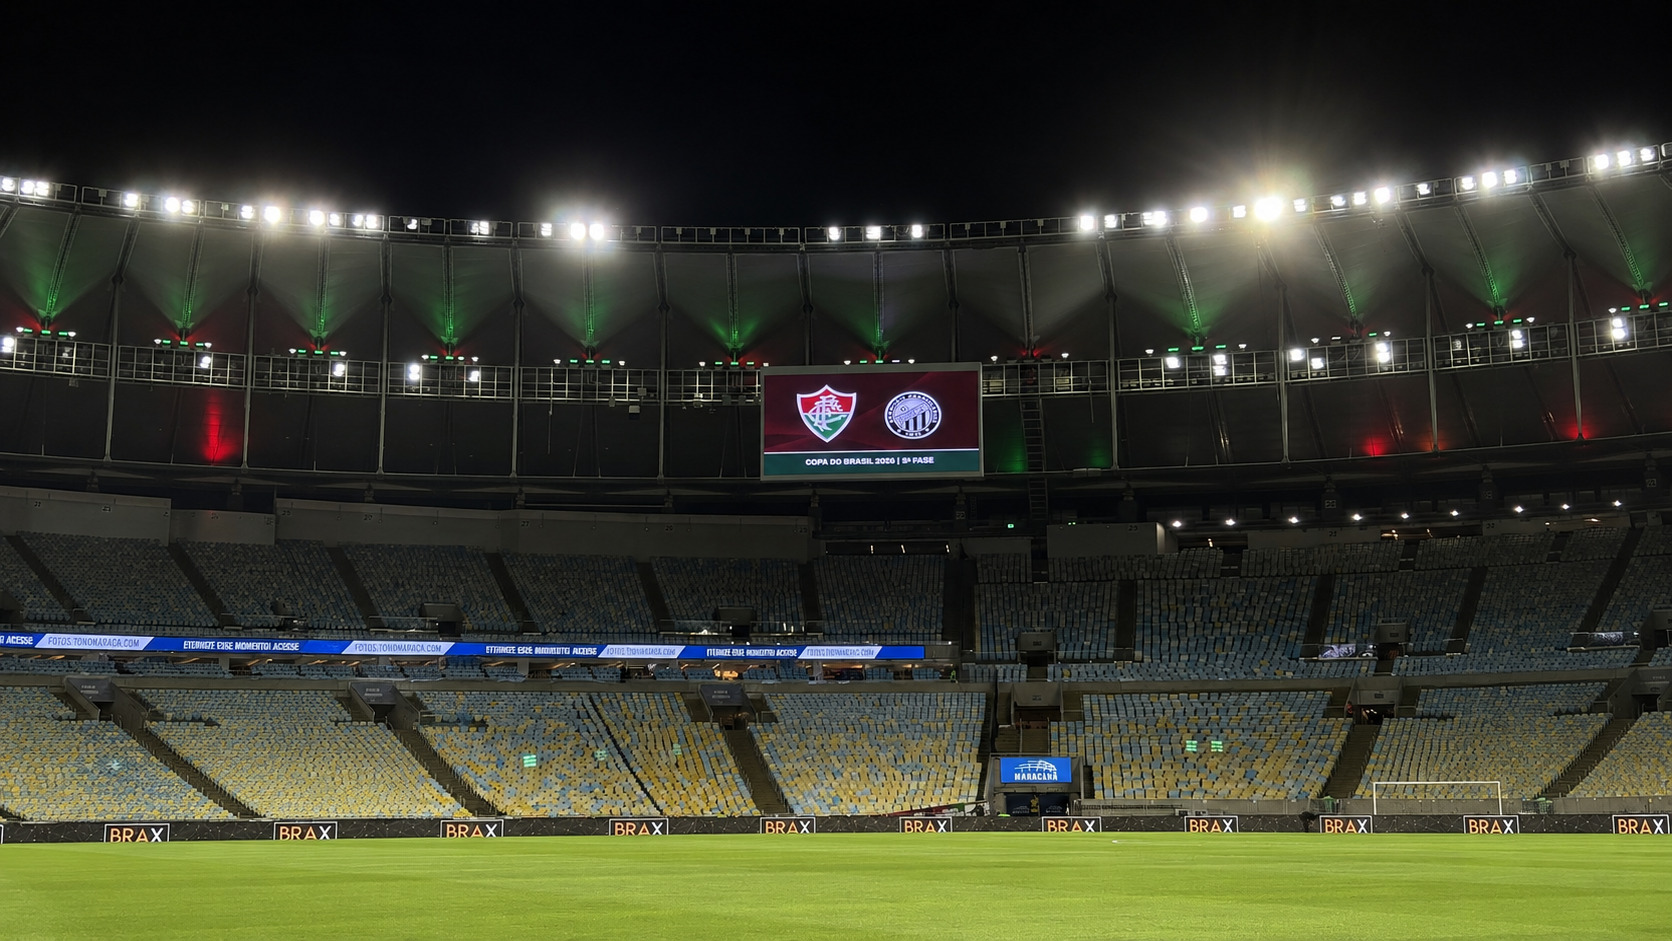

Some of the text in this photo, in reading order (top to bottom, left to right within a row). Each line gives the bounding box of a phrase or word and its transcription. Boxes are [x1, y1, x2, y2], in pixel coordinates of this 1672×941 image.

[843, 457, 874, 465] BRASIL
[912, 456, 934, 464] FASE
[6, 635, 33, 645] ACESSE
[446, 823, 497, 838] BRAX
[614, 822, 663, 836] BRAX
[765, 820, 810, 834] BRAX
[904, 820, 947, 833] BRAX
[1047, 819, 1095, 832] BRAX
[1189, 819, 1233, 833] BRAX
[1324, 819, 1367, 834] BRAX
[1469, 819, 1513, 834] BRAX
[1618, 819, 1664, 834] BRAX
[110, 828, 163, 843] BRAX
[279, 826, 330, 840] BRAX
